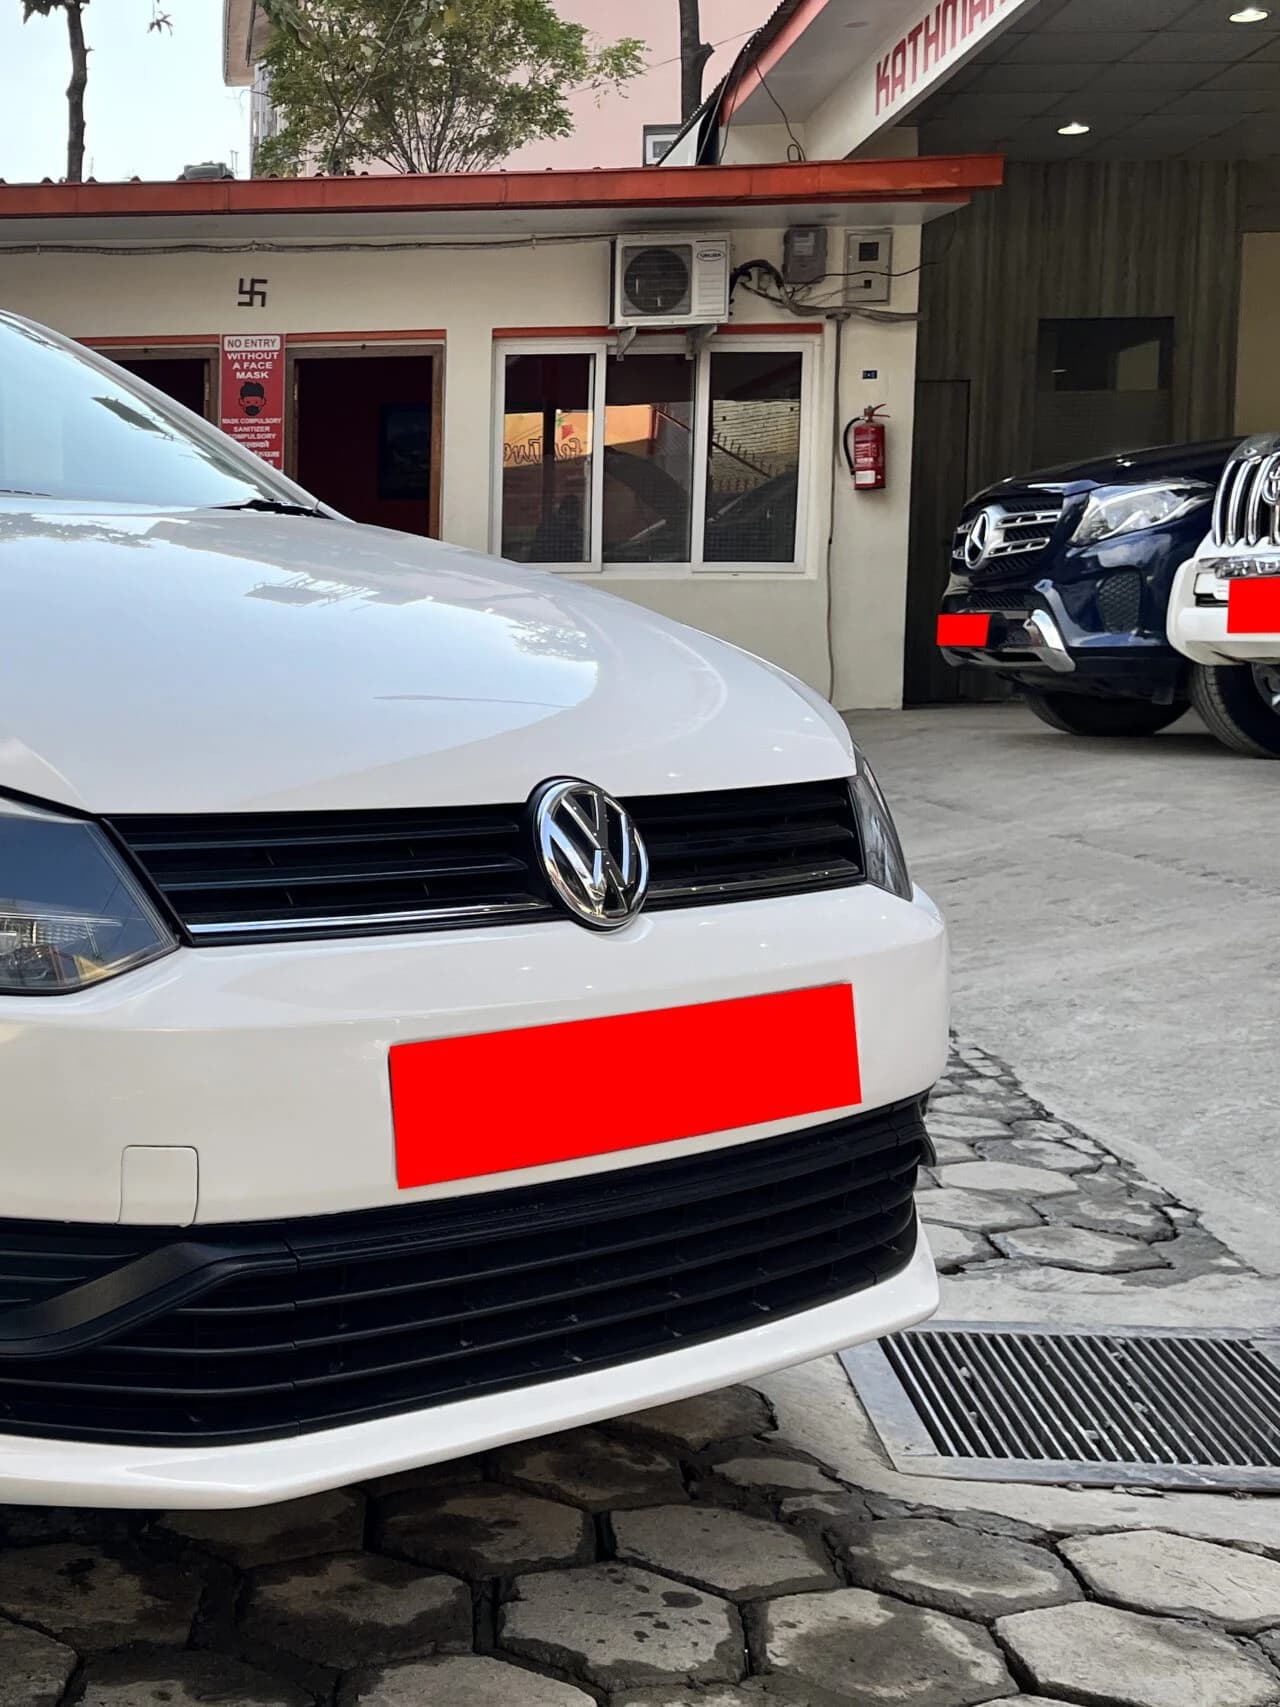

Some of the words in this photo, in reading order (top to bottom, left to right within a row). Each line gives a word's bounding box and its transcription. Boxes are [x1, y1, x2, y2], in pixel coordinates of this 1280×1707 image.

[227, 338, 242, 349] NO
[245, 338, 277, 349] ENTRY
[227, 351, 279, 360] WITHOUT
[232, 361, 241, 370] A
[244, 361, 273, 370] FACE
[236, 371, 269, 379] MASK
